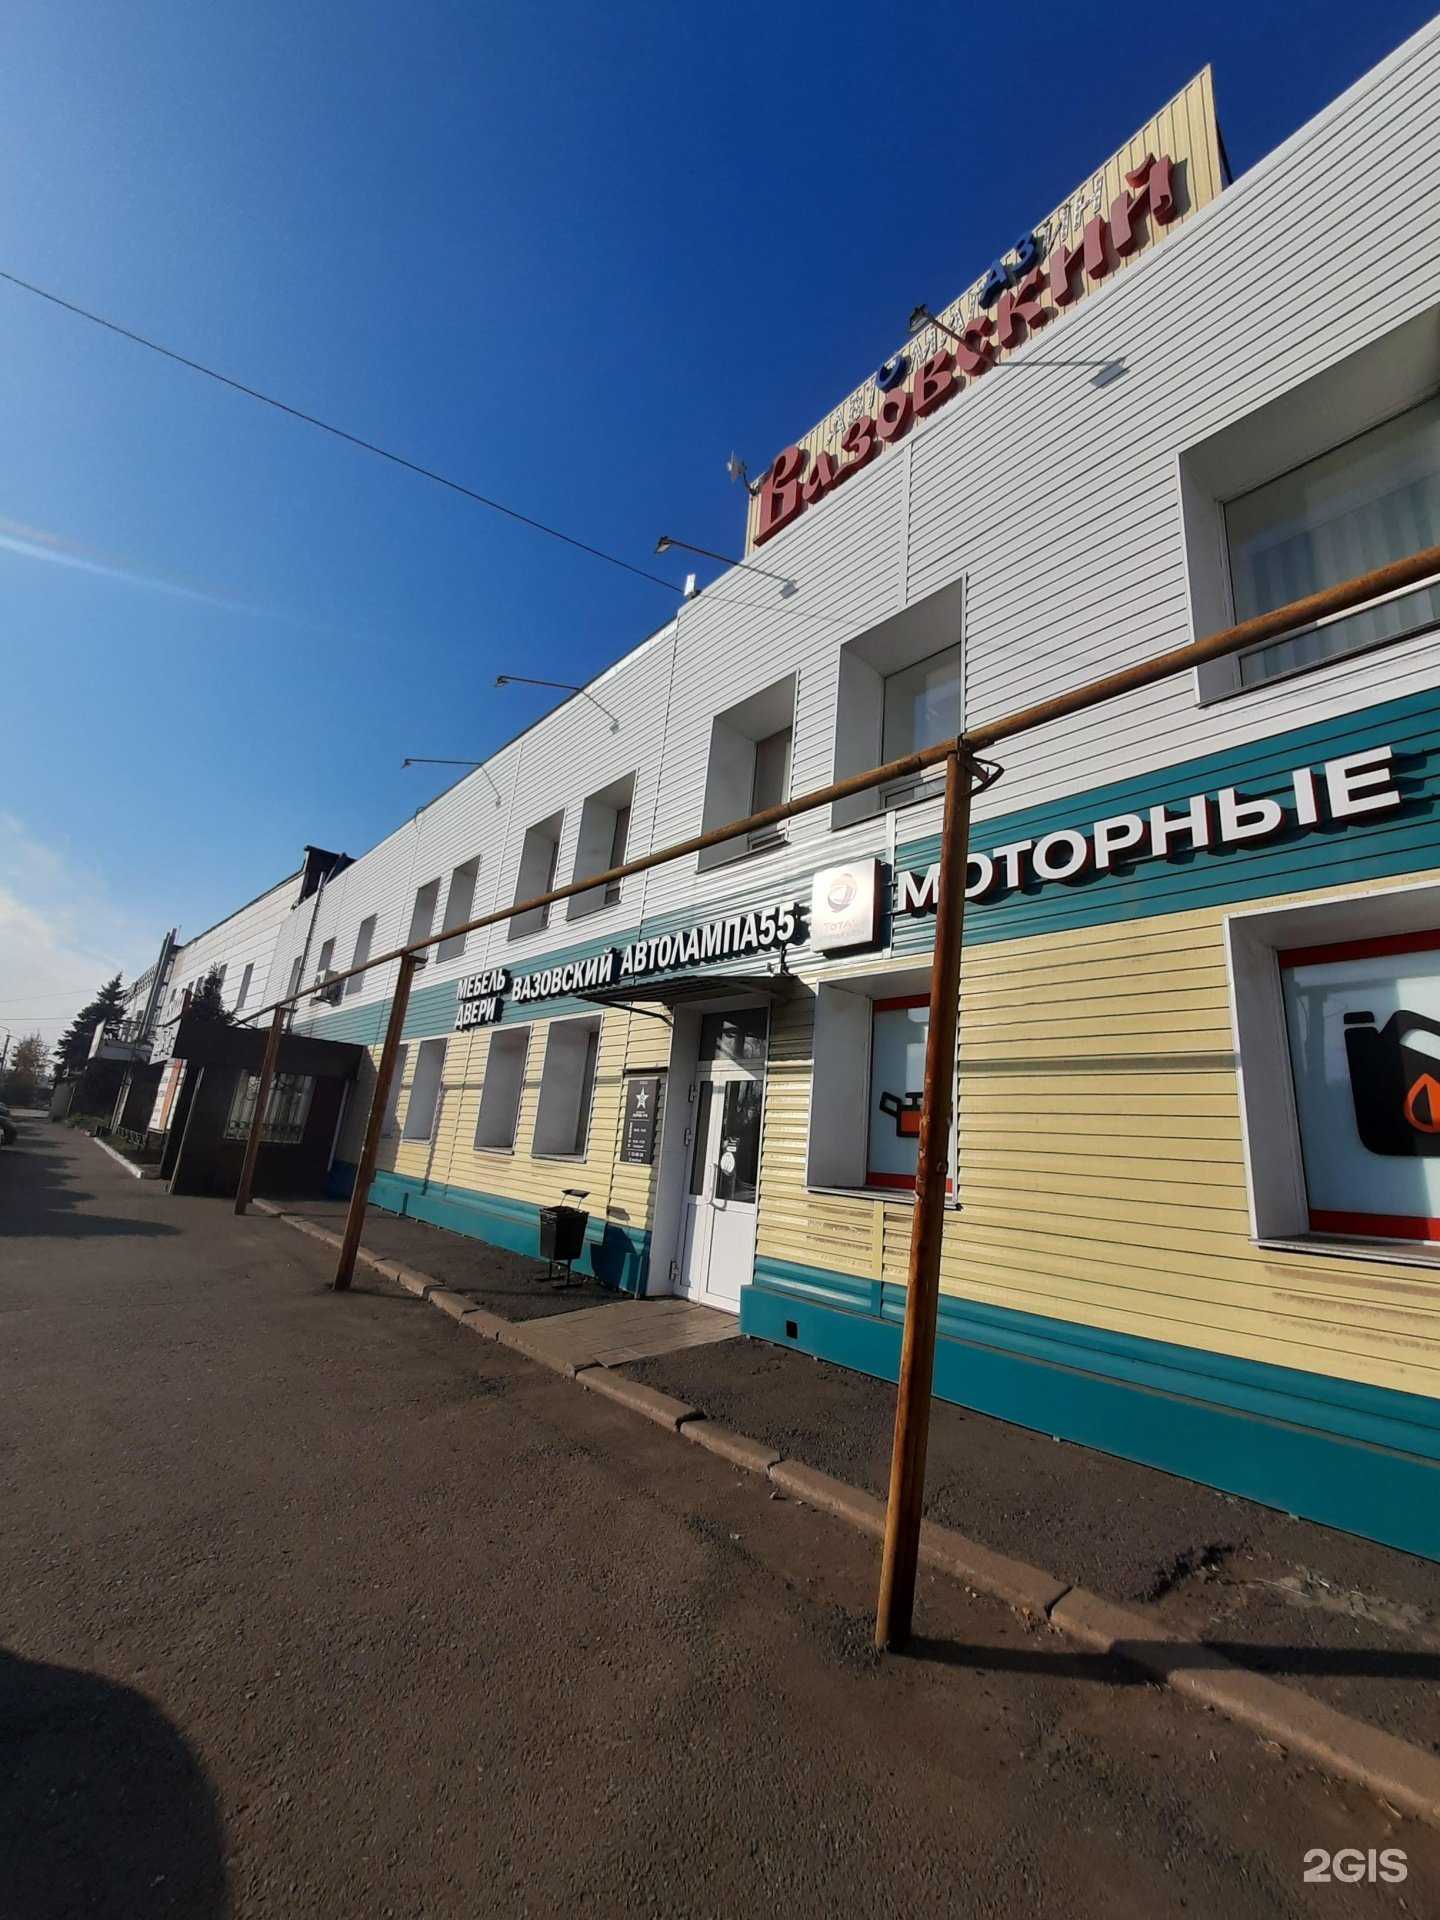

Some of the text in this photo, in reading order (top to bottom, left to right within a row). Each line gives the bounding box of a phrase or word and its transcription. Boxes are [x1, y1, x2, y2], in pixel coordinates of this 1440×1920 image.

[897, 745, 1400, 914] МОТОРНЫЕ
[456, 967, 506, 1000] МЕБЕЛЬ
[511, 900, 795, 1001] ВАЗОВСКИЙ АВТОЛАМПА55
[454, 997, 497, 1030] ДВЕРИ
